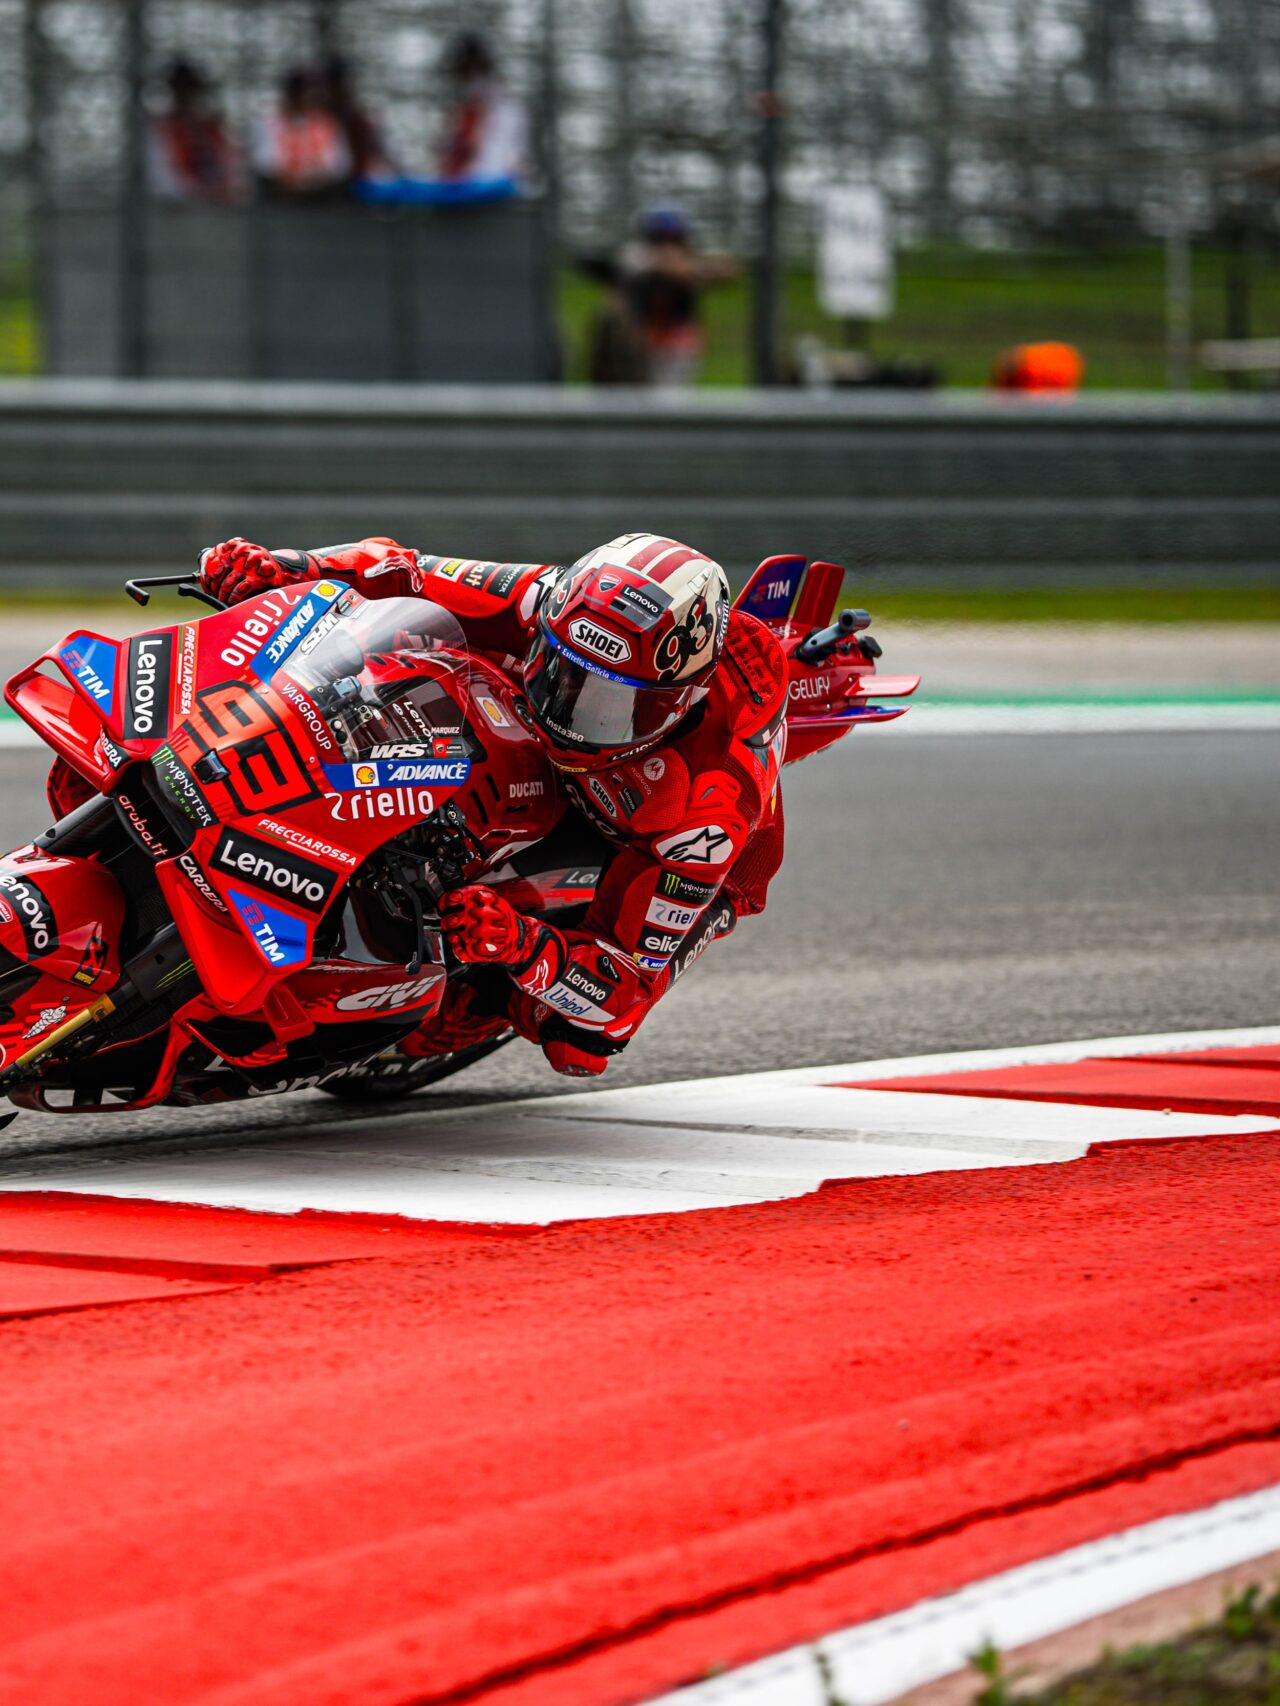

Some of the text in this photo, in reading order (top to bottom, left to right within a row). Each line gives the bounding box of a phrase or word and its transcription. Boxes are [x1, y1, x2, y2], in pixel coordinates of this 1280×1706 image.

[623, 587, 659, 613] Lenovo
[767, 579, 791, 600] TIM
[265, 599, 315, 664] ADVANCE
[576, 624, 624, 659] SHOEI
[181, 625, 196, 715] FRECCIAROSSA
[562, 648, 585, 667] Estrella
[585, 662, 610, 679] Galicia
[77, 665, 111, 699] TIM
[133, 638, 163, 733] Lenovo
[788, 675, 830, 700] GELLIFY
[281, 682, 332, 751] VARGROUP
[430, 726, 460, 735] MARQUEZ
[546, 716, 585, 743] Insta360
[369, 743, 428, 759] WRS
[612, 734, 664, 761] Lenovo
[387, 764, 468, 782] ADVANCE
[509, 781, 544, 799] DUCATI
[165, 775, 196, 820] ENERGY
[166, 760, 212, 828] MONSTER
[591, 780, 616, 815] SHOEI
[118, 795, 169, 857] aruba.it
[257, 818, 358, 866] FRECCIAROSSA
[180, 855, 228, 912] CARRERA
[219, 839, 325, 902] Lenovo
[255, 922, 287, 963] TIM
[674, 909, 731, 981] Lenovo
[336, 973, 445, 1011] GIVI
[549, 987, 592, 1016] Unipol
[565, 967, 606, 1001] Lenovo
